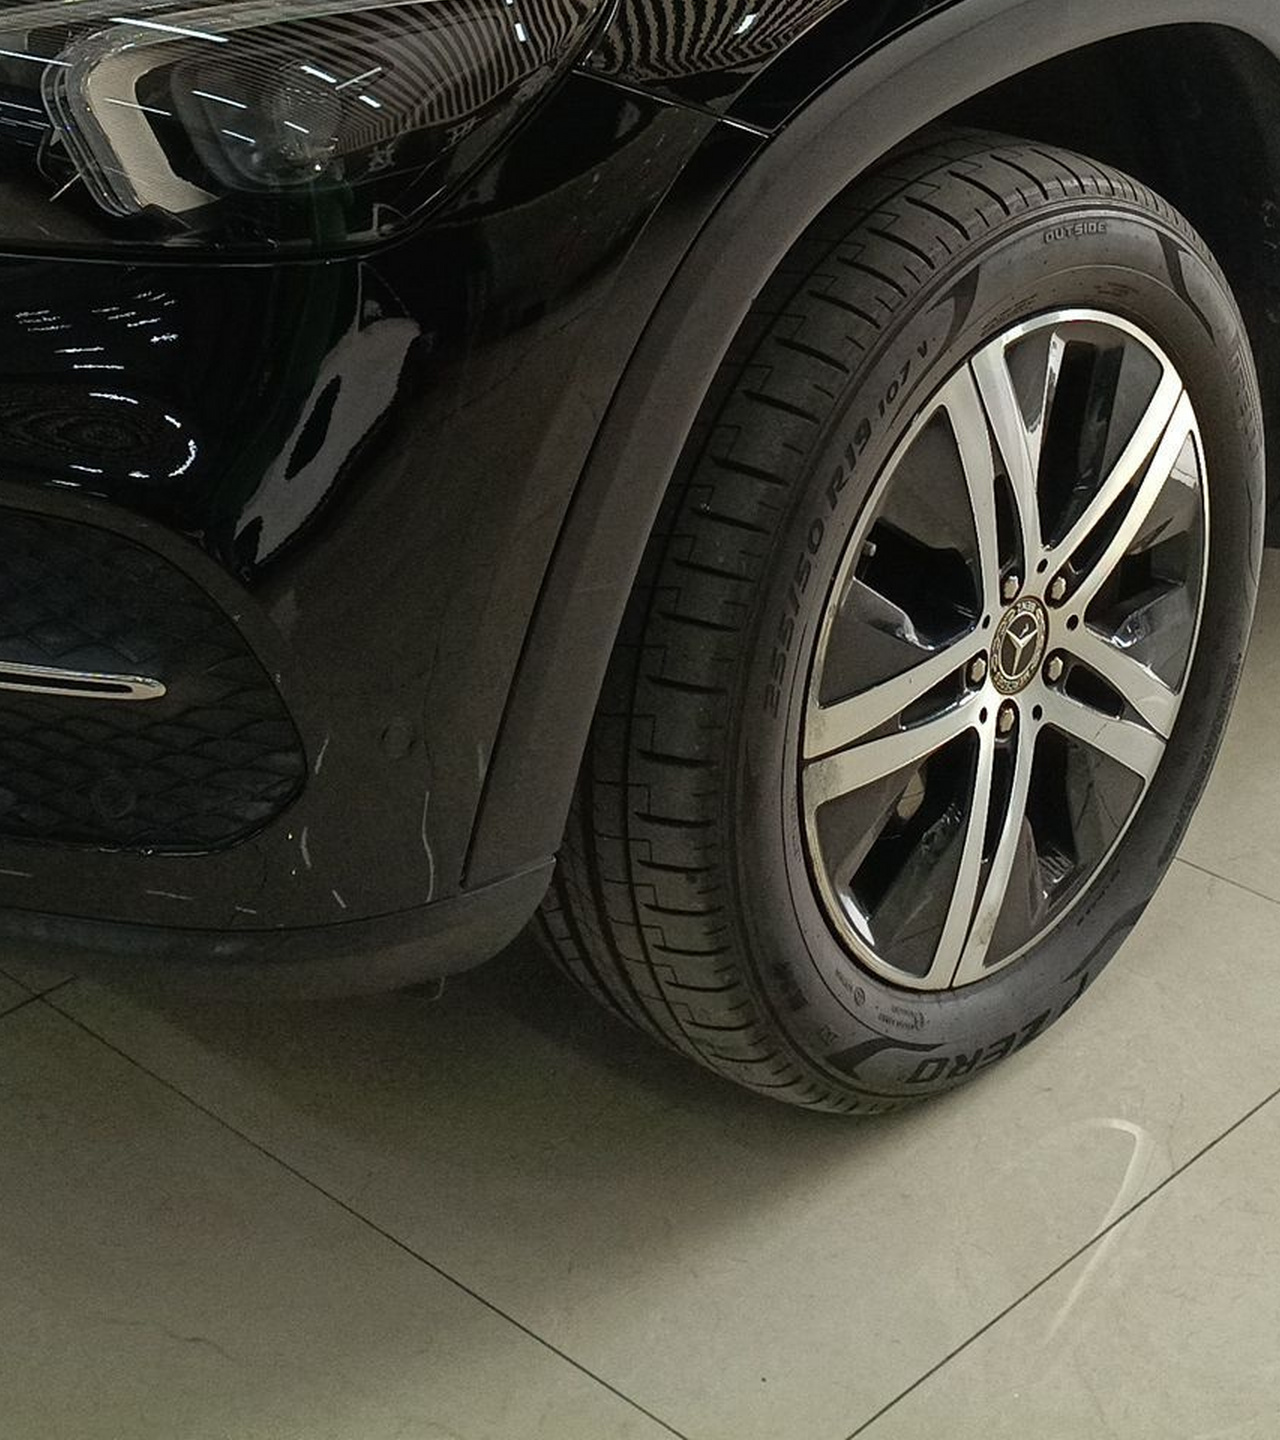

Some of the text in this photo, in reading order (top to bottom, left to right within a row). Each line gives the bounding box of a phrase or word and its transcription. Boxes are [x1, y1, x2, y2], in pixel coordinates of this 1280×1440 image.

[1044, 221, 1108, 244] OUTSIDE
[827, 417, 872, 510] R19
[877, 366, 911, 419] 107
